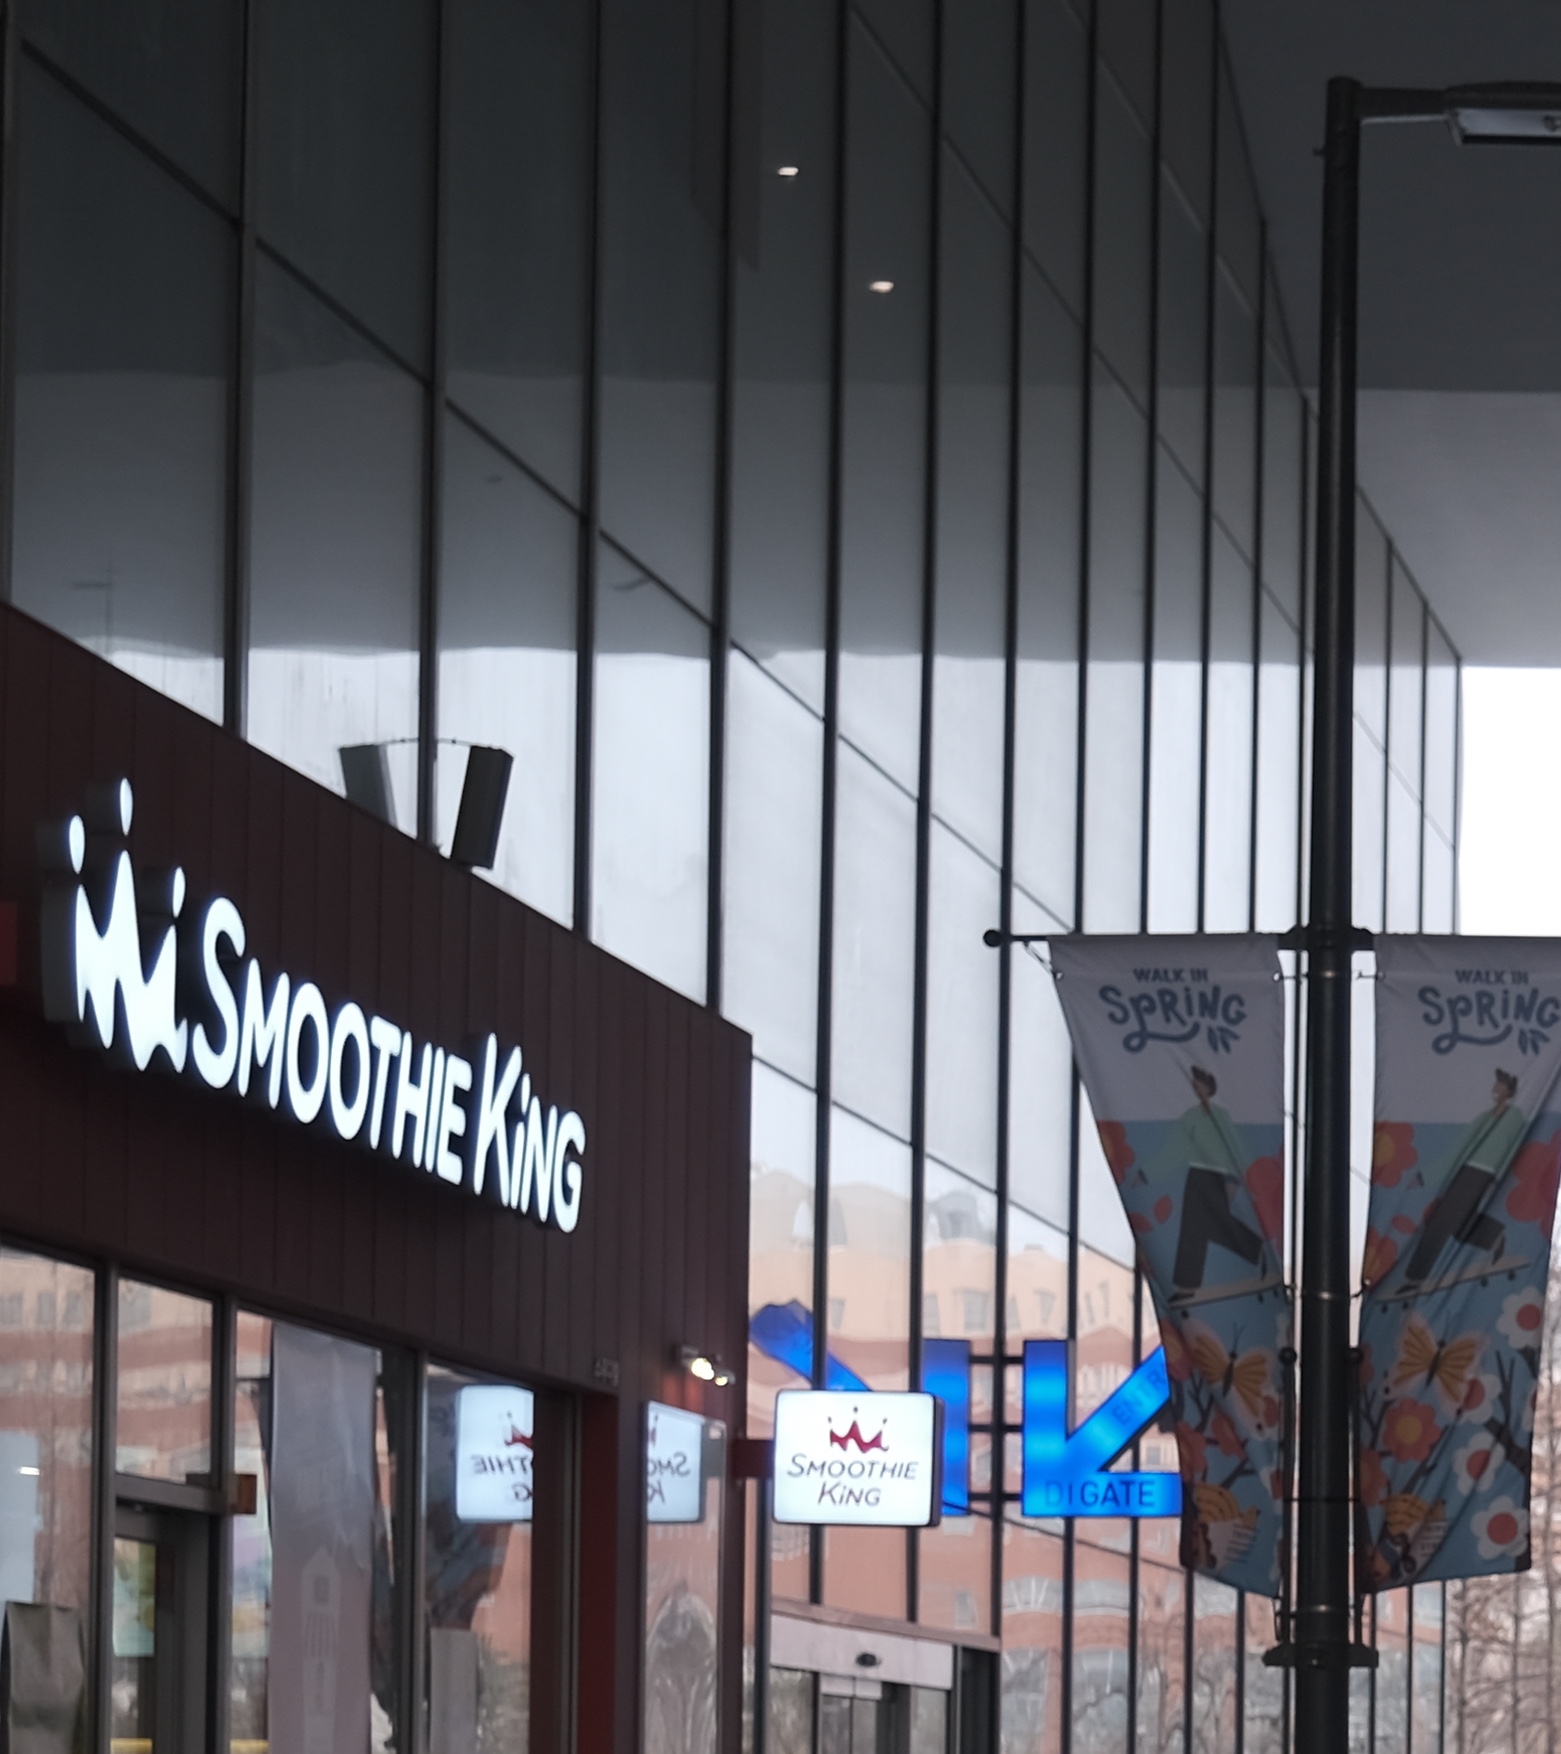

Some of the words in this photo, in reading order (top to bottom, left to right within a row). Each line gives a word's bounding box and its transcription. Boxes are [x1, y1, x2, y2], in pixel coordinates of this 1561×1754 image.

[1133, 967, 1184, 982] WALK
[1190, 967, 1208, 982] IN
[1455, 969, 1505, 984] WALK
[1511, 969, 1528, 984] IN
[192, 896, 472, 1186] SMOOTHIE
[787, 1453, 919, 1479] SMOOTHIE
[1080, 1481, 1155, 1506] GATE
